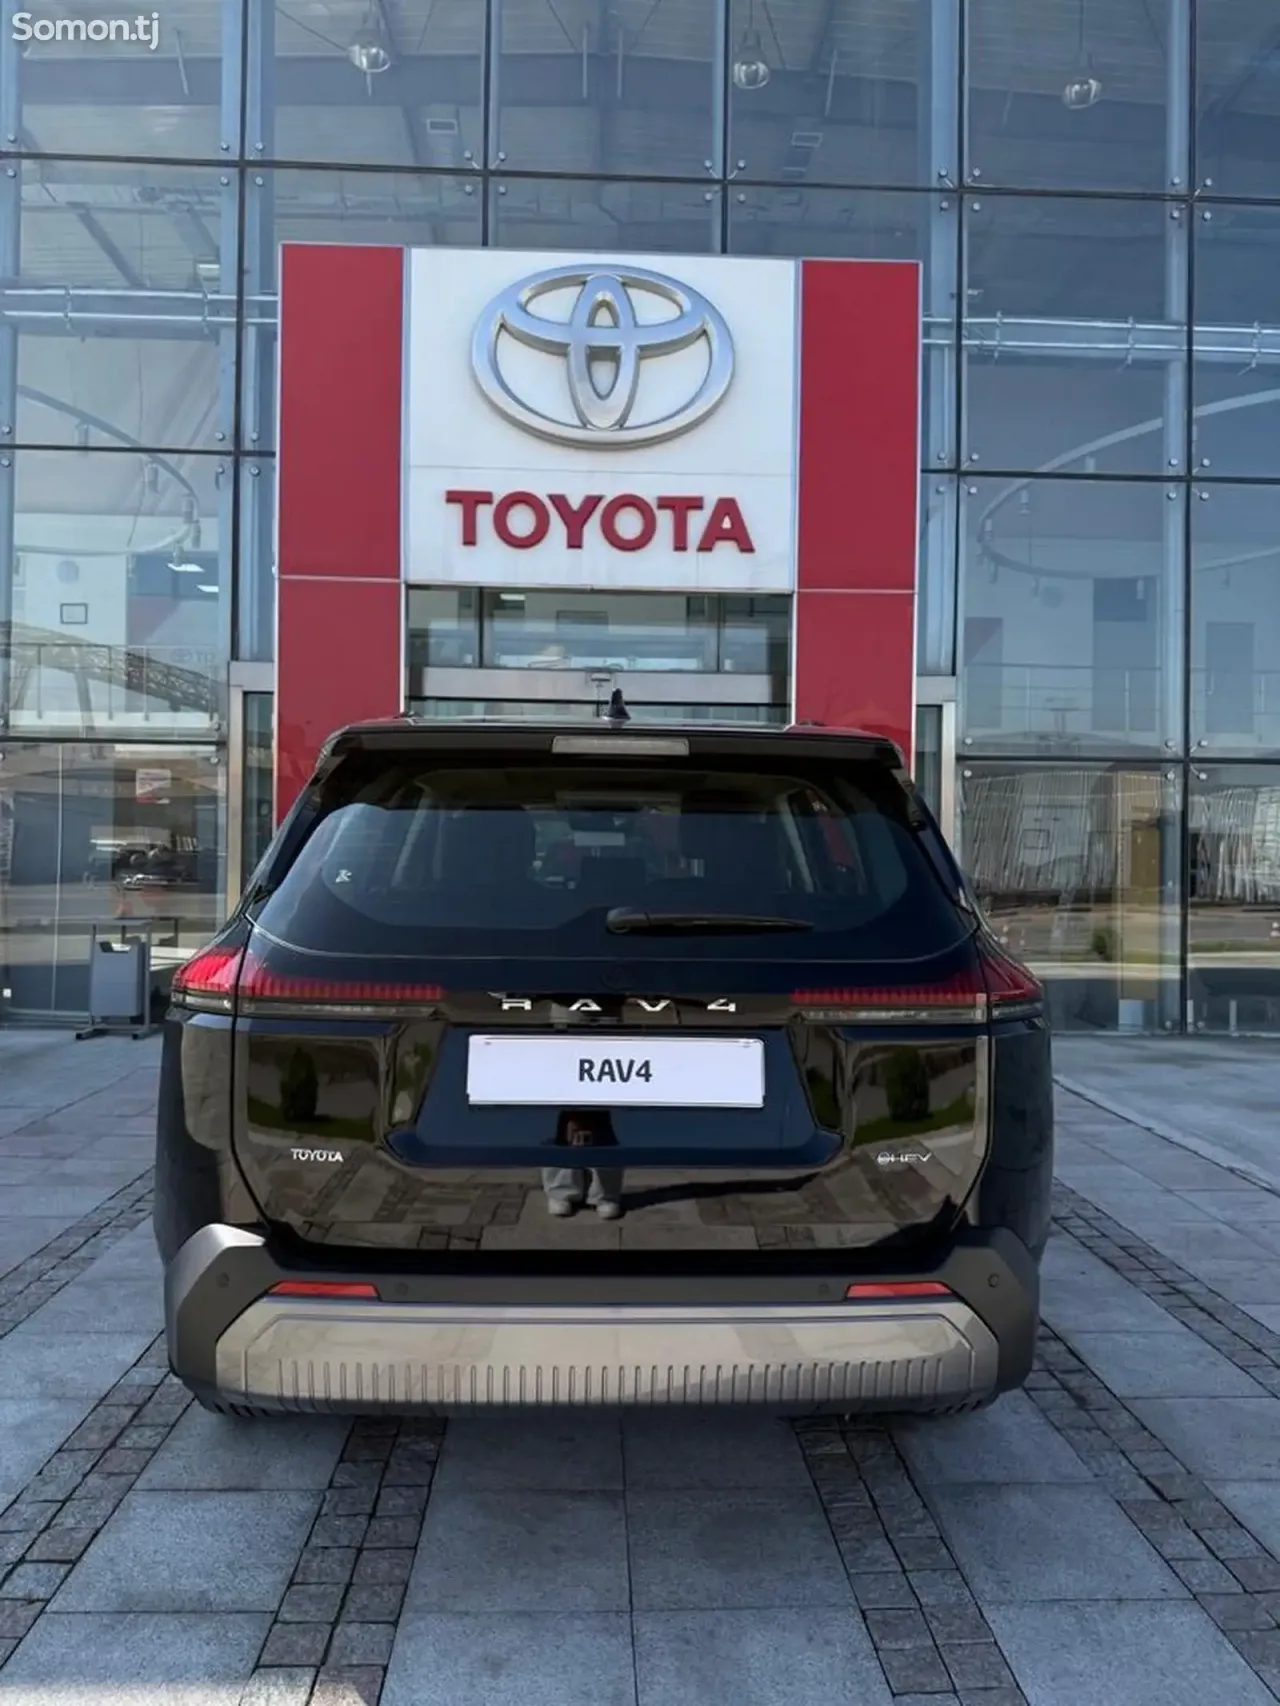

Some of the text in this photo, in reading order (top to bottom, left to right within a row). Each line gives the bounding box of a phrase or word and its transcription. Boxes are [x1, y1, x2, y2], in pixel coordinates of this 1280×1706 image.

[445, 489, 756, 553] TOYOTA
[578, 1058, 653, 1083] RAV4
[290, 1147, 345, 1163] TOYOTA
